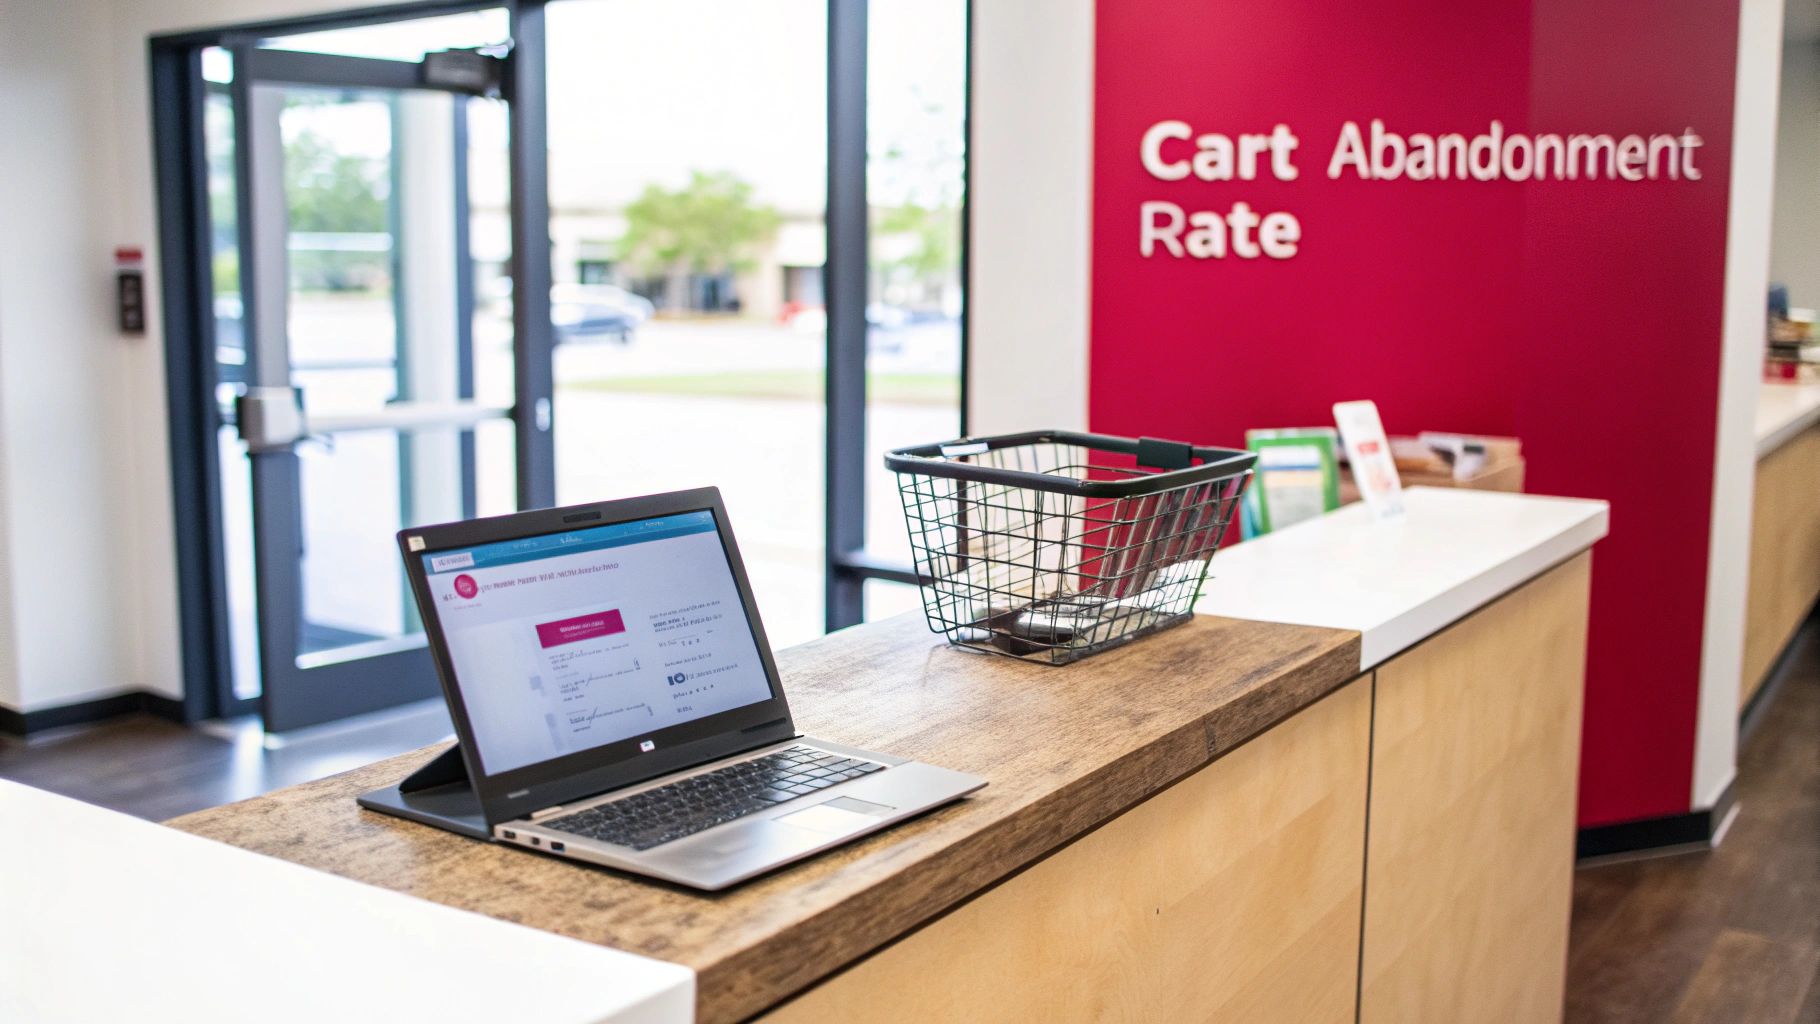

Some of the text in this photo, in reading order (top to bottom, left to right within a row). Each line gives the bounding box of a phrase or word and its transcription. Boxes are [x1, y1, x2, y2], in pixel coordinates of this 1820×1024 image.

[1140, 119, 1703, 181] Cart Abandonment
[1140, 201, 1301, 259] Rate
